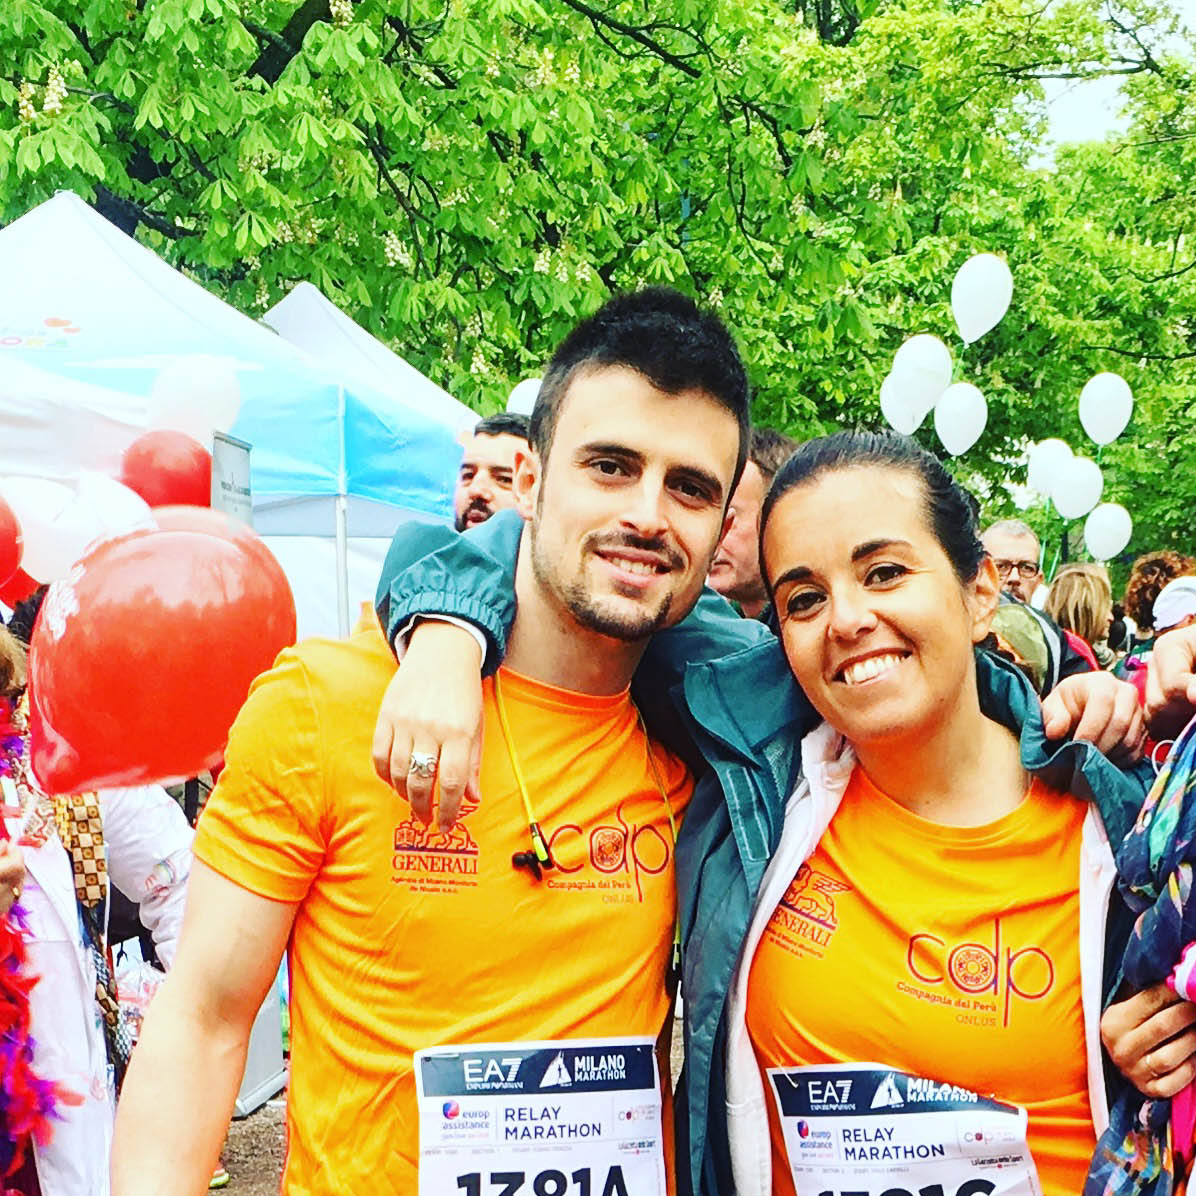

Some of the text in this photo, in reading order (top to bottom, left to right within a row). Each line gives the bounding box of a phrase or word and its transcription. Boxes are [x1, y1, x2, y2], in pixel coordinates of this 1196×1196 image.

[391, 854, 479, 875] GENERALI
[897, 981, 952, 1005] Compagnia
[463, 1057, 523, 1083] EA7
[573, 1054, 626, 1073] MILANO
[574, 1069, 627, 1082] MARATHON
[808, 1080, 853, 1103] EA7
[907, 1090, 979, 1103] MARATHON
[462, 1110, 490, 1119] europ
[504, 1106, 562, 1122] RELAY
[442, 1120, 490, 1130] assistance
[504, 1123, 601, 1140] MARATHON
[842, 1128, 895, 1142] RELAY
[844, 1144, 945, 1160] MARATHON
